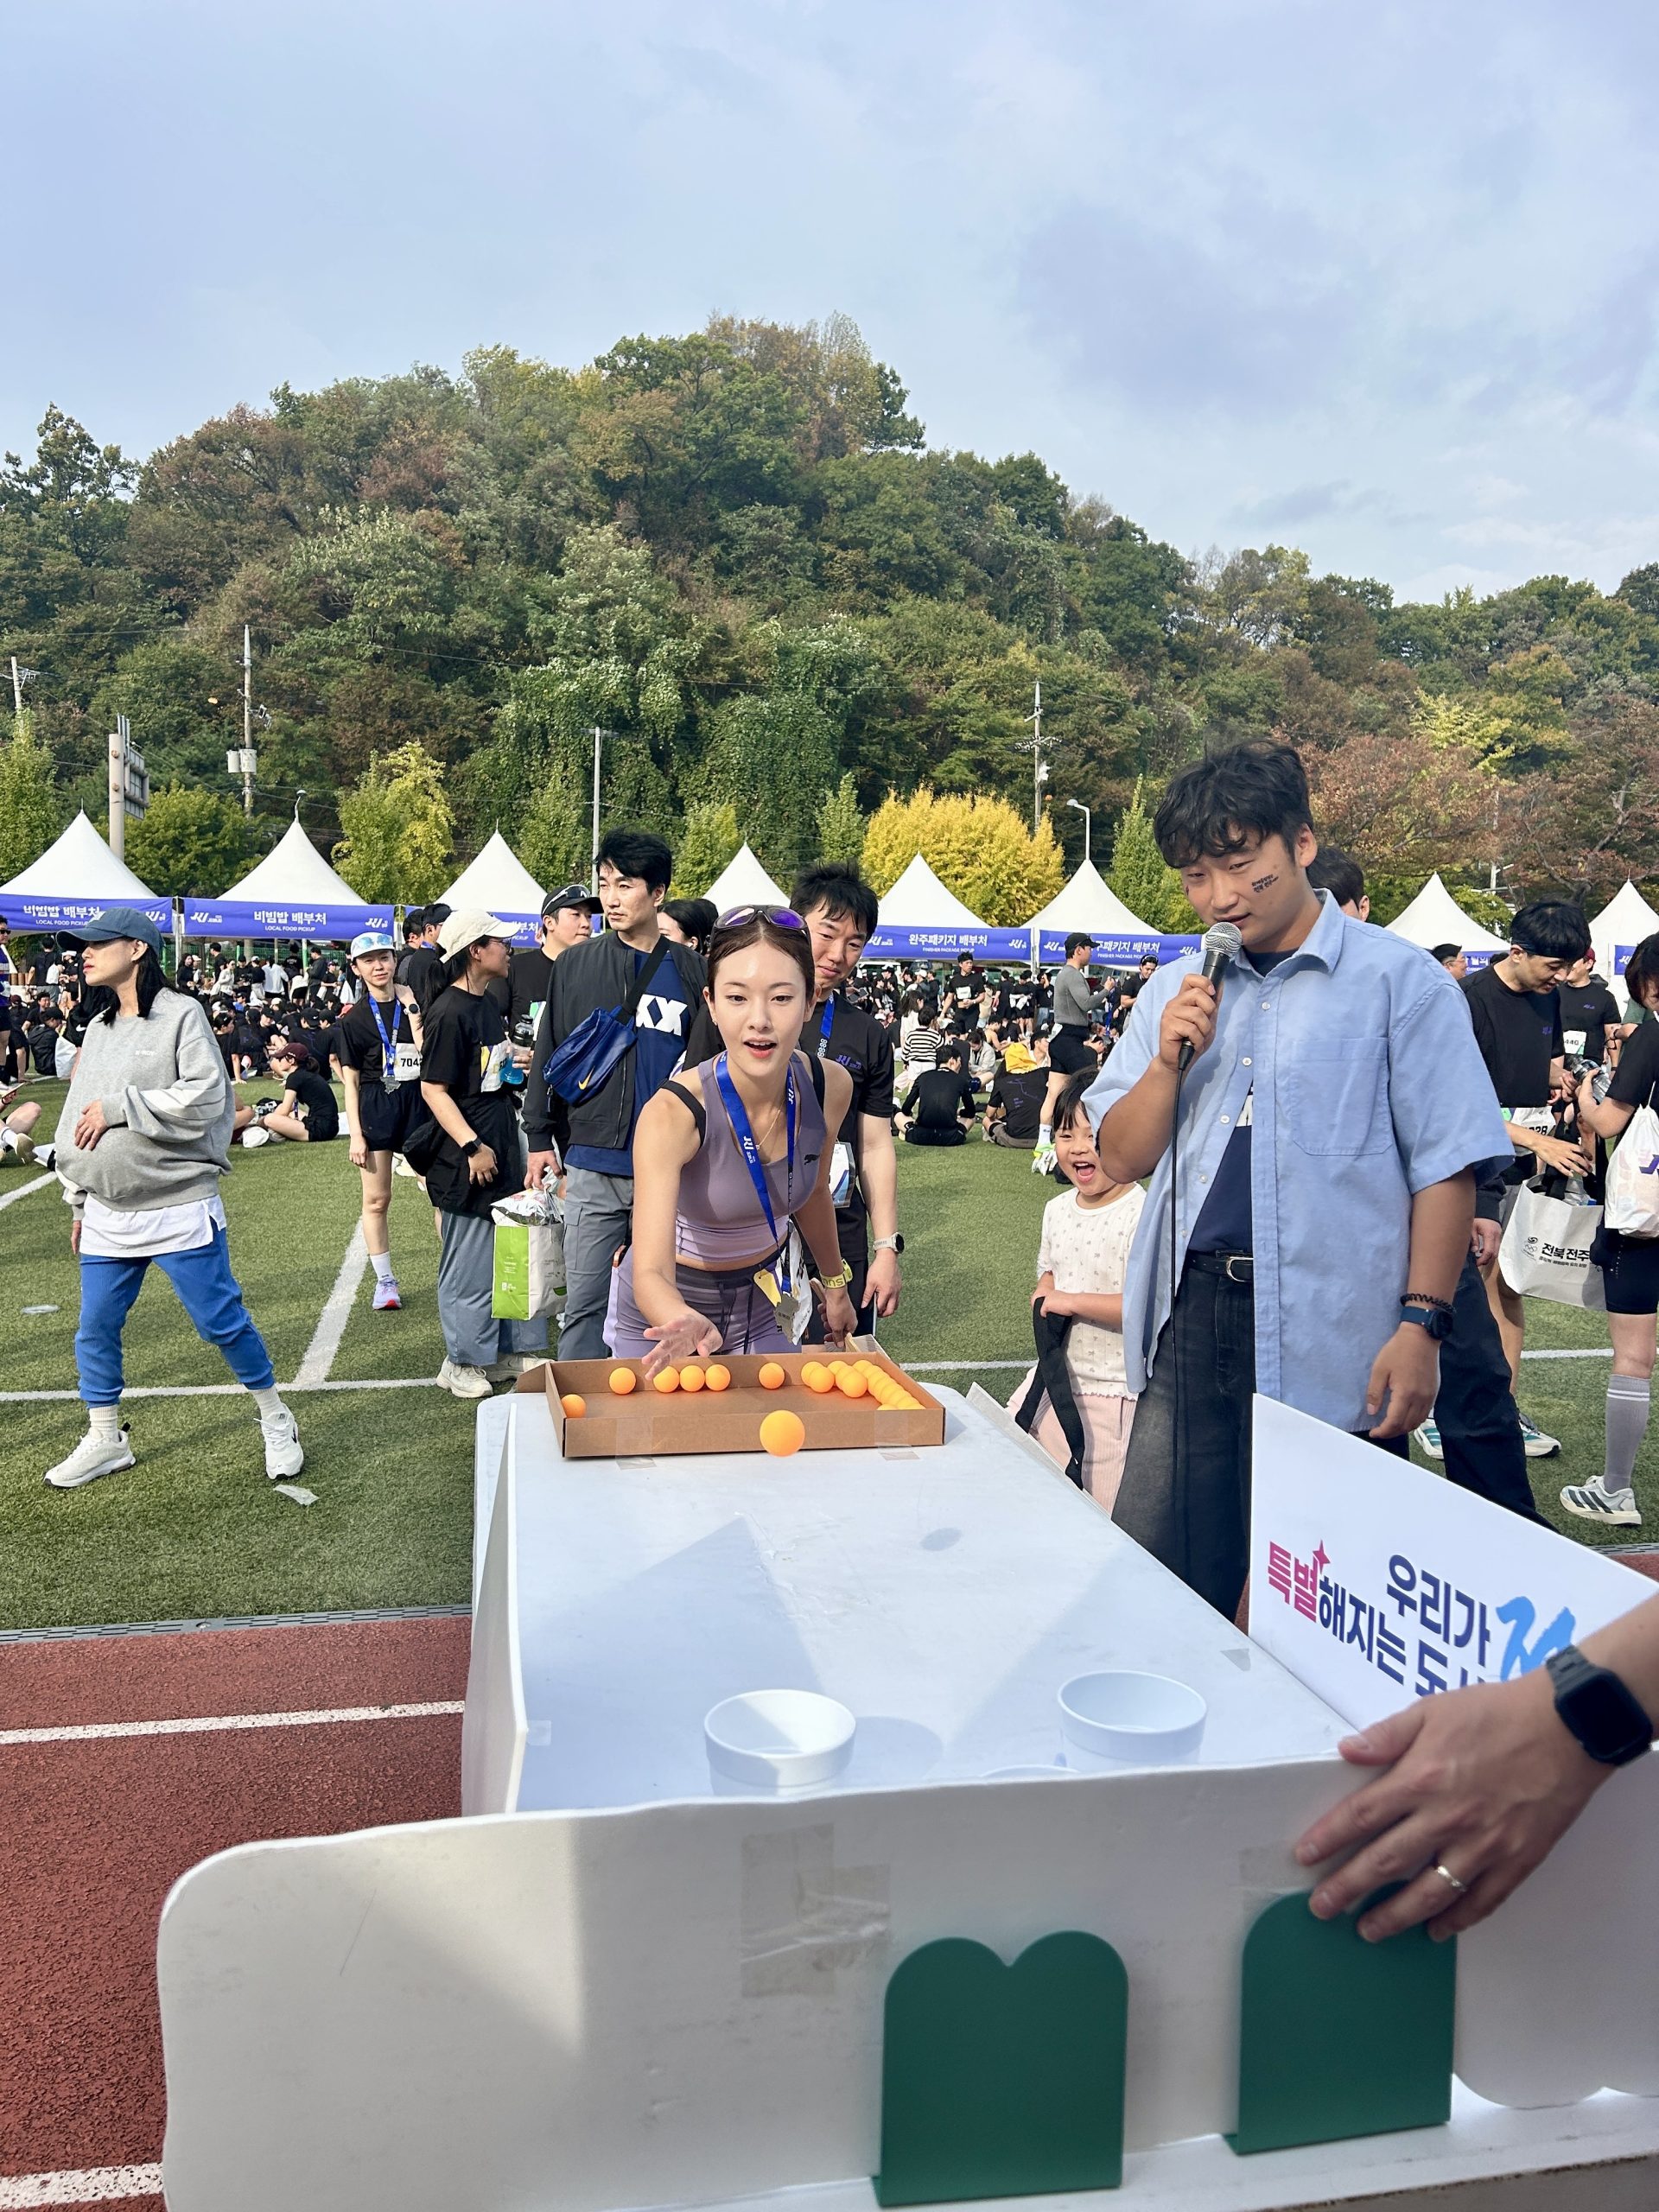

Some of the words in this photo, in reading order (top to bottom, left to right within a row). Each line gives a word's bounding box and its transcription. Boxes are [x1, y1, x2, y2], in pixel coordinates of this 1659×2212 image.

[23, 905, 60, 918] 비빔밥
[63, 906, 101, 918] 배부처
[254, 911, 288, 925] 비빔밥
[292, 912, 327, 925] 배부처
[515, 921, 539, 933] 부처
[908, 933, 957, 946] 완주패키지
[959, 934, 988, 947] 배부처
[1095, 940, 1130, 952] 주패키지
[1133, 942, 1160, 953] 배부처
[1267, 1540, 1407, 1686] 특별해지는
[1386, 1554, 1491, 1667] 우리가
